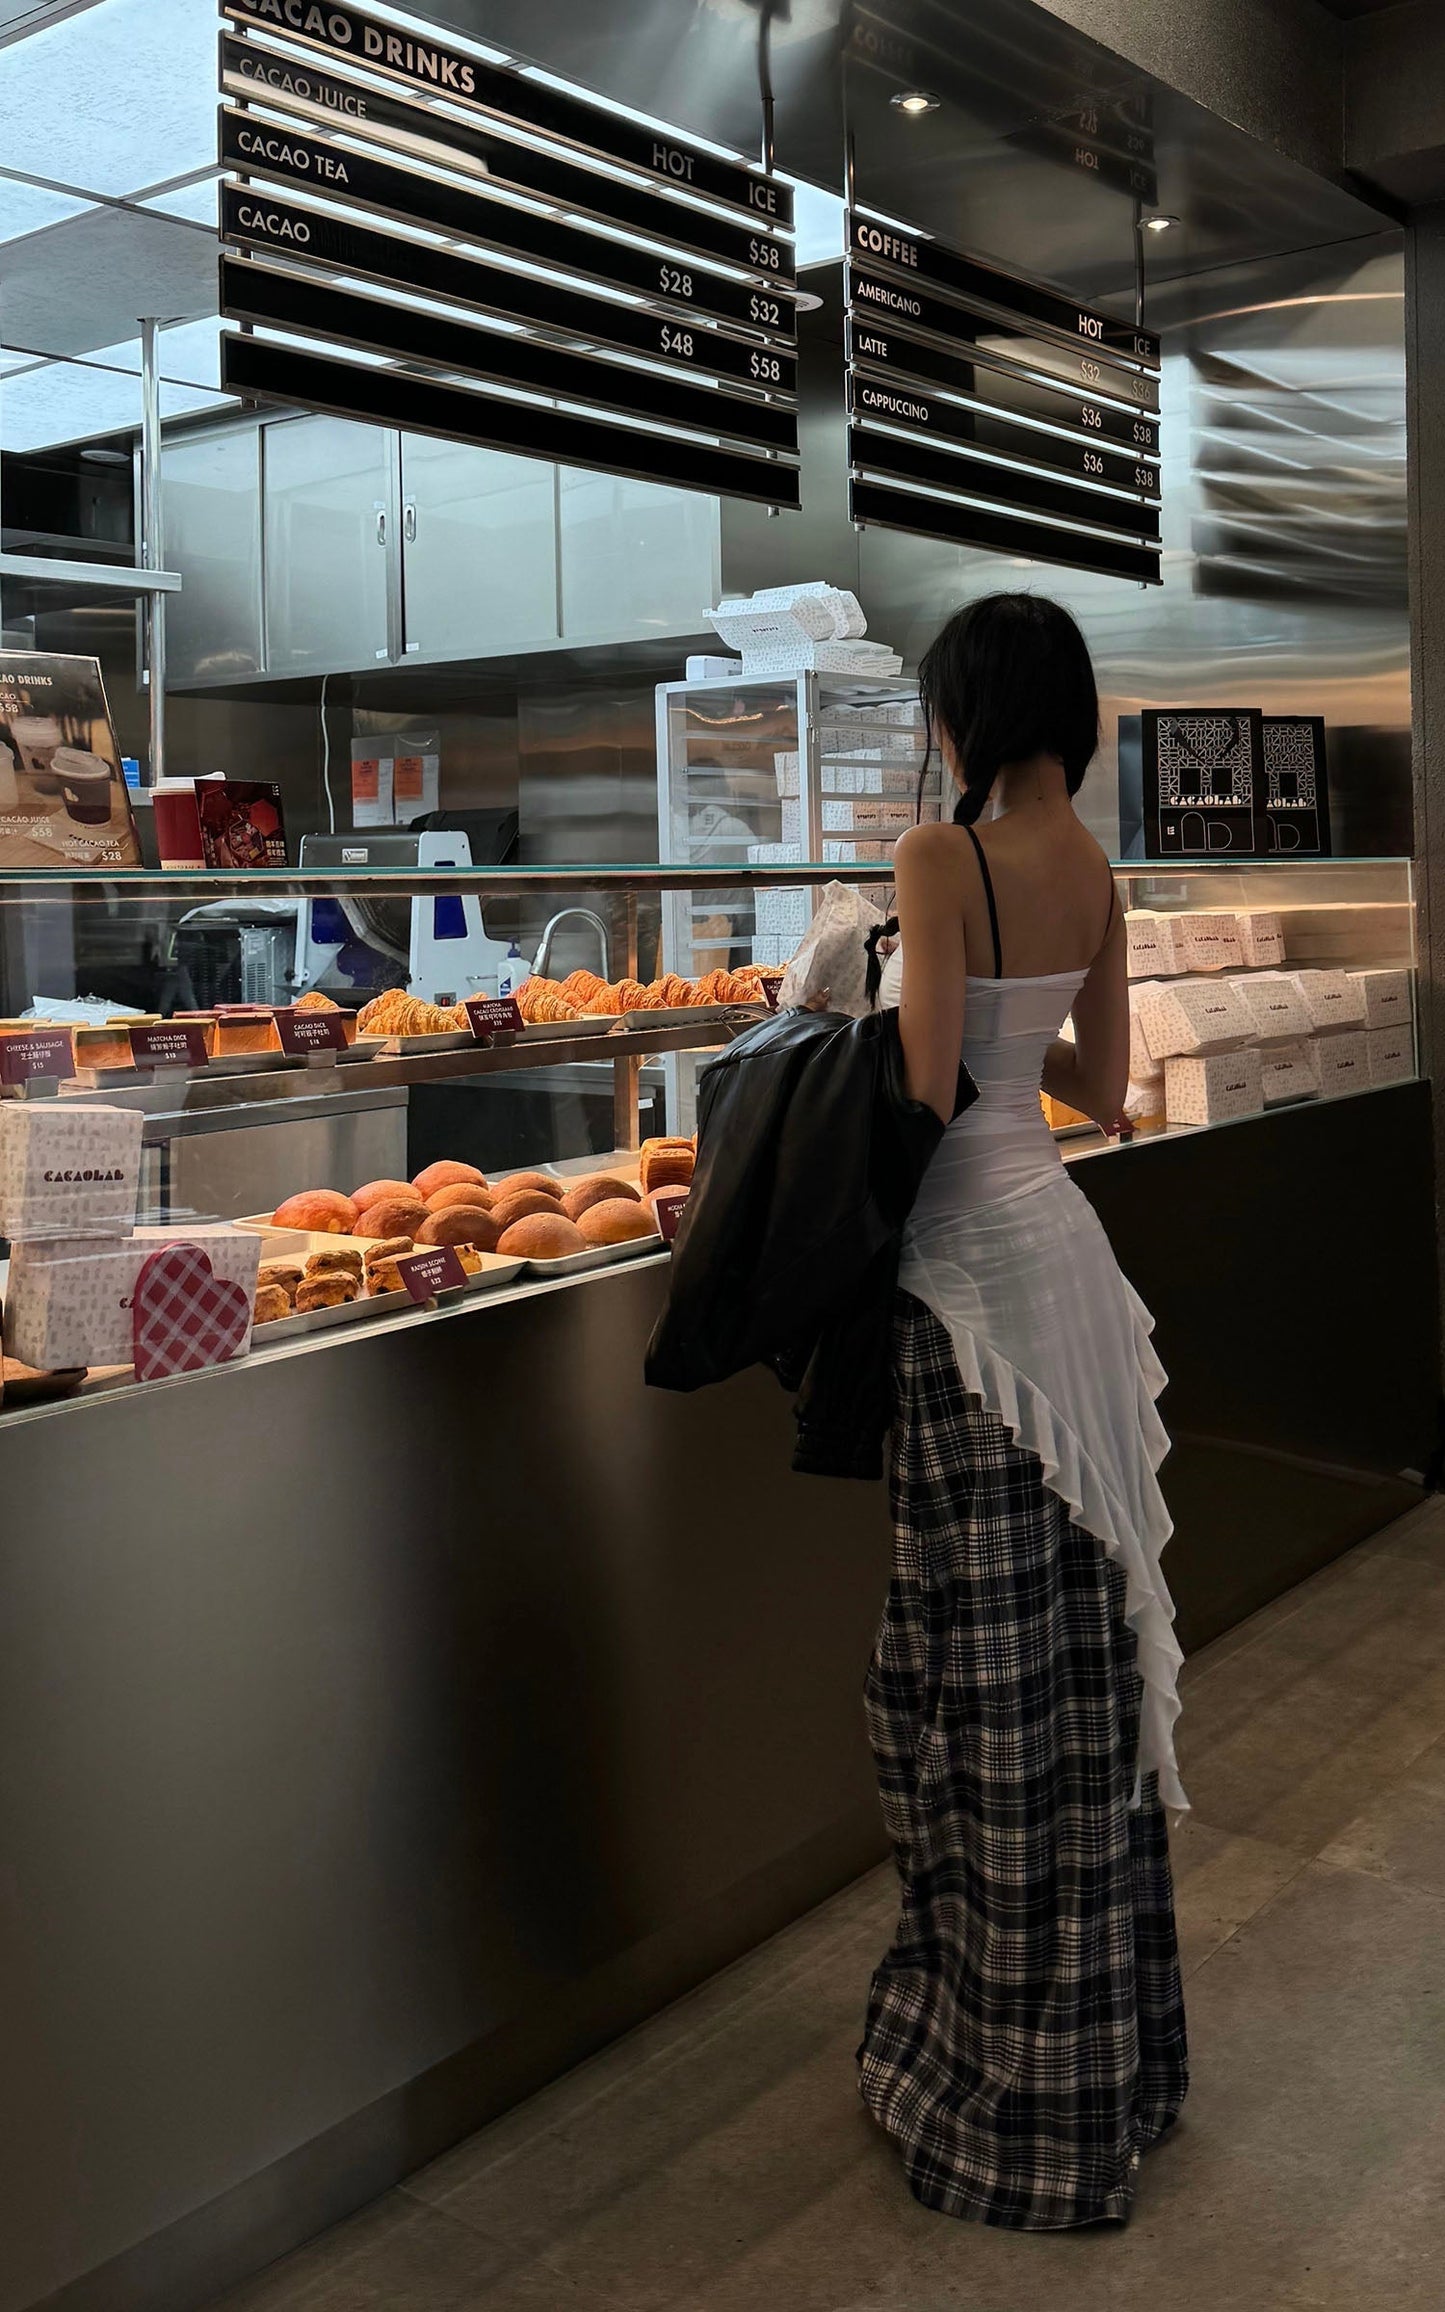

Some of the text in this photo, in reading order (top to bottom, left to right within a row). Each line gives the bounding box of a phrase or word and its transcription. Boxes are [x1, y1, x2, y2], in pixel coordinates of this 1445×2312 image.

[363, 25, 476, 94] DRINKS
[239, 58, 367, 119] CACAO JUICE
[237, 131, 349, 184] CACAO TEA
[652, 143, 777, 213] HOT ICE
[238, 206, 310, 243] CACAO
[749, 238, 780, 269] $58
[857, 225, 918, 268] COFFEE
[659, 265, 779, 325] $28 $32
[857, 281, 921, 316] AMERICANO
[660, 325, 780, 382] $48 $58
[858, 335, 888, 357] LATTE
[1078, 313, 1151, 357] HOT ICE
[1080, 360, 1101, 383] $32
[862, 389, 929, 421] CAPPUCCINO
[1081, 405, 1152, 444] $36 $38
[1083, 451, 1154, 488] $36 $38
[17, 674, 53, 686] DRINKS
[31, 827, 53, 838] $58
[101, 851, 122, 861] $28
[44, 1170, 124, 1182] CACAOLAB
